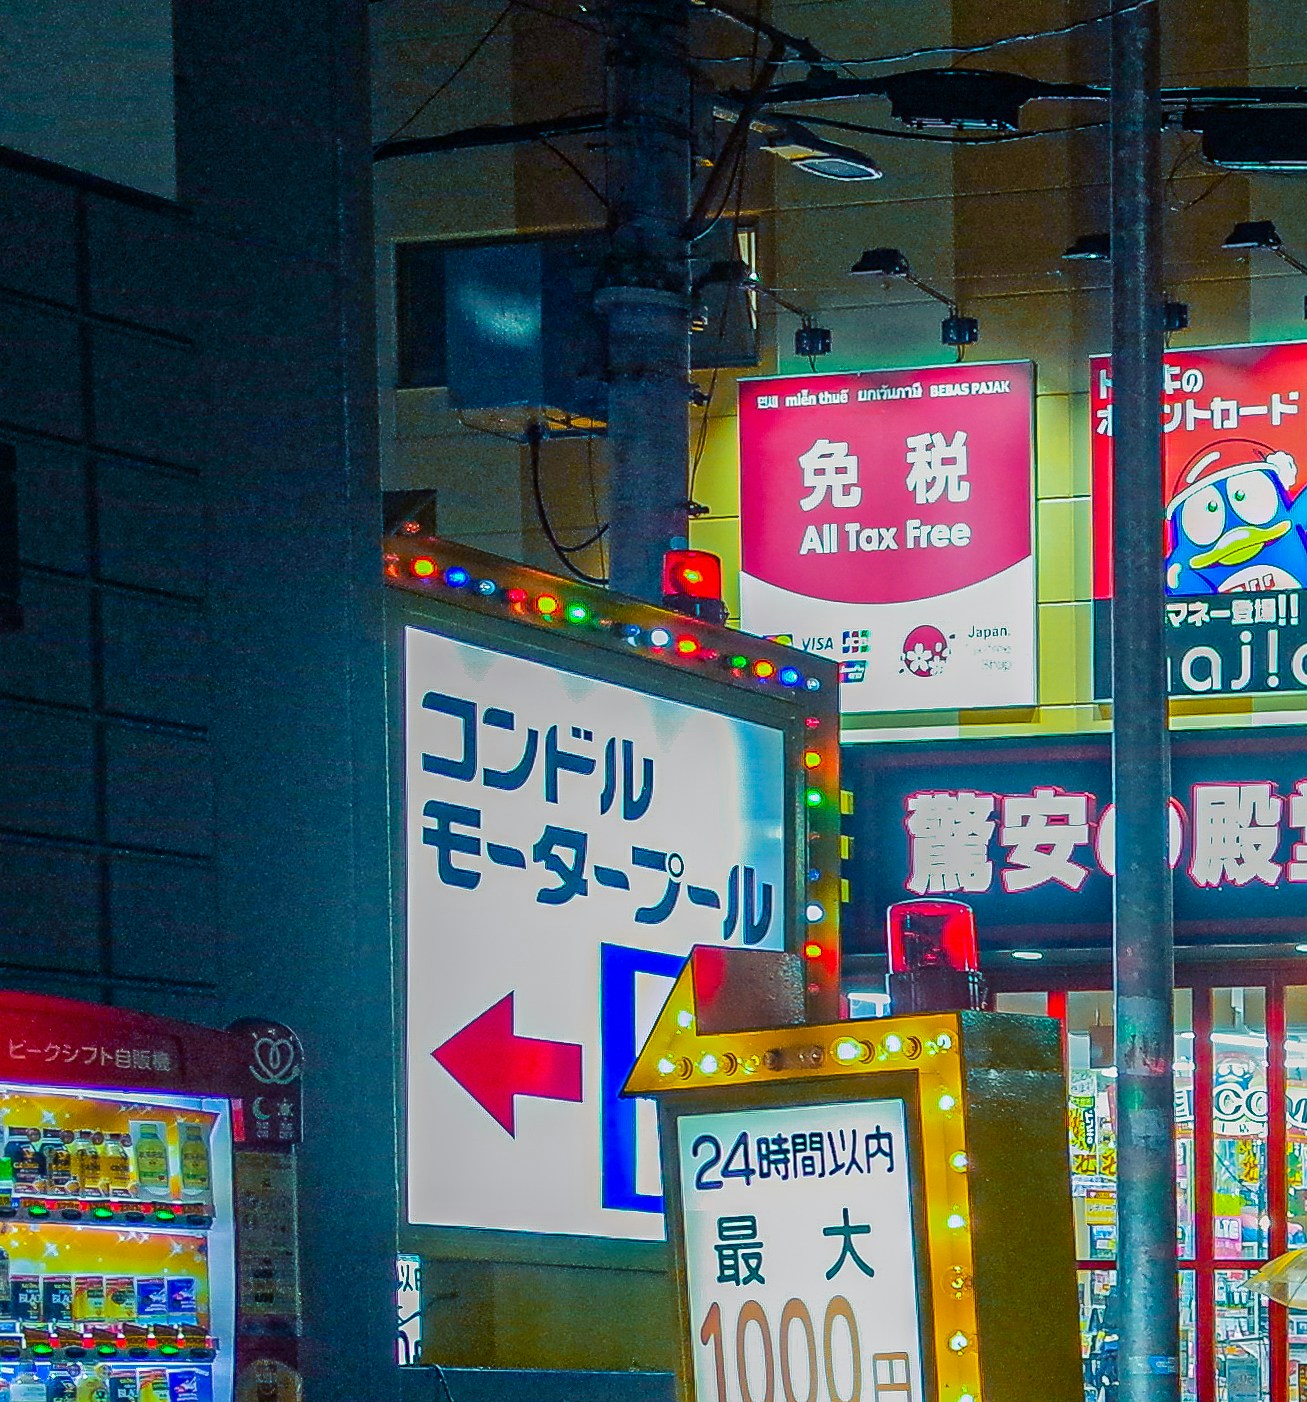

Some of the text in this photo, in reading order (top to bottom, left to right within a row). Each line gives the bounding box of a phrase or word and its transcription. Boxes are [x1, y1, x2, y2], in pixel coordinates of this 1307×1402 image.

[930, 379, 1010, 397] BEBAS PAJAK
[799, 430, 971, 511] 免税
[799, 518, 971, 555] All Tax Free
[802, 635, 834, 652] VISA
[1165, 593, 1299, 628] マネー登場!!
[422, 691, 655, 821] コンドル
[422, 799, 773, 945] モータープール
[692, 1124, 896, 1192] 24時間以内
[714, 1207, 875, 1286] 最大
